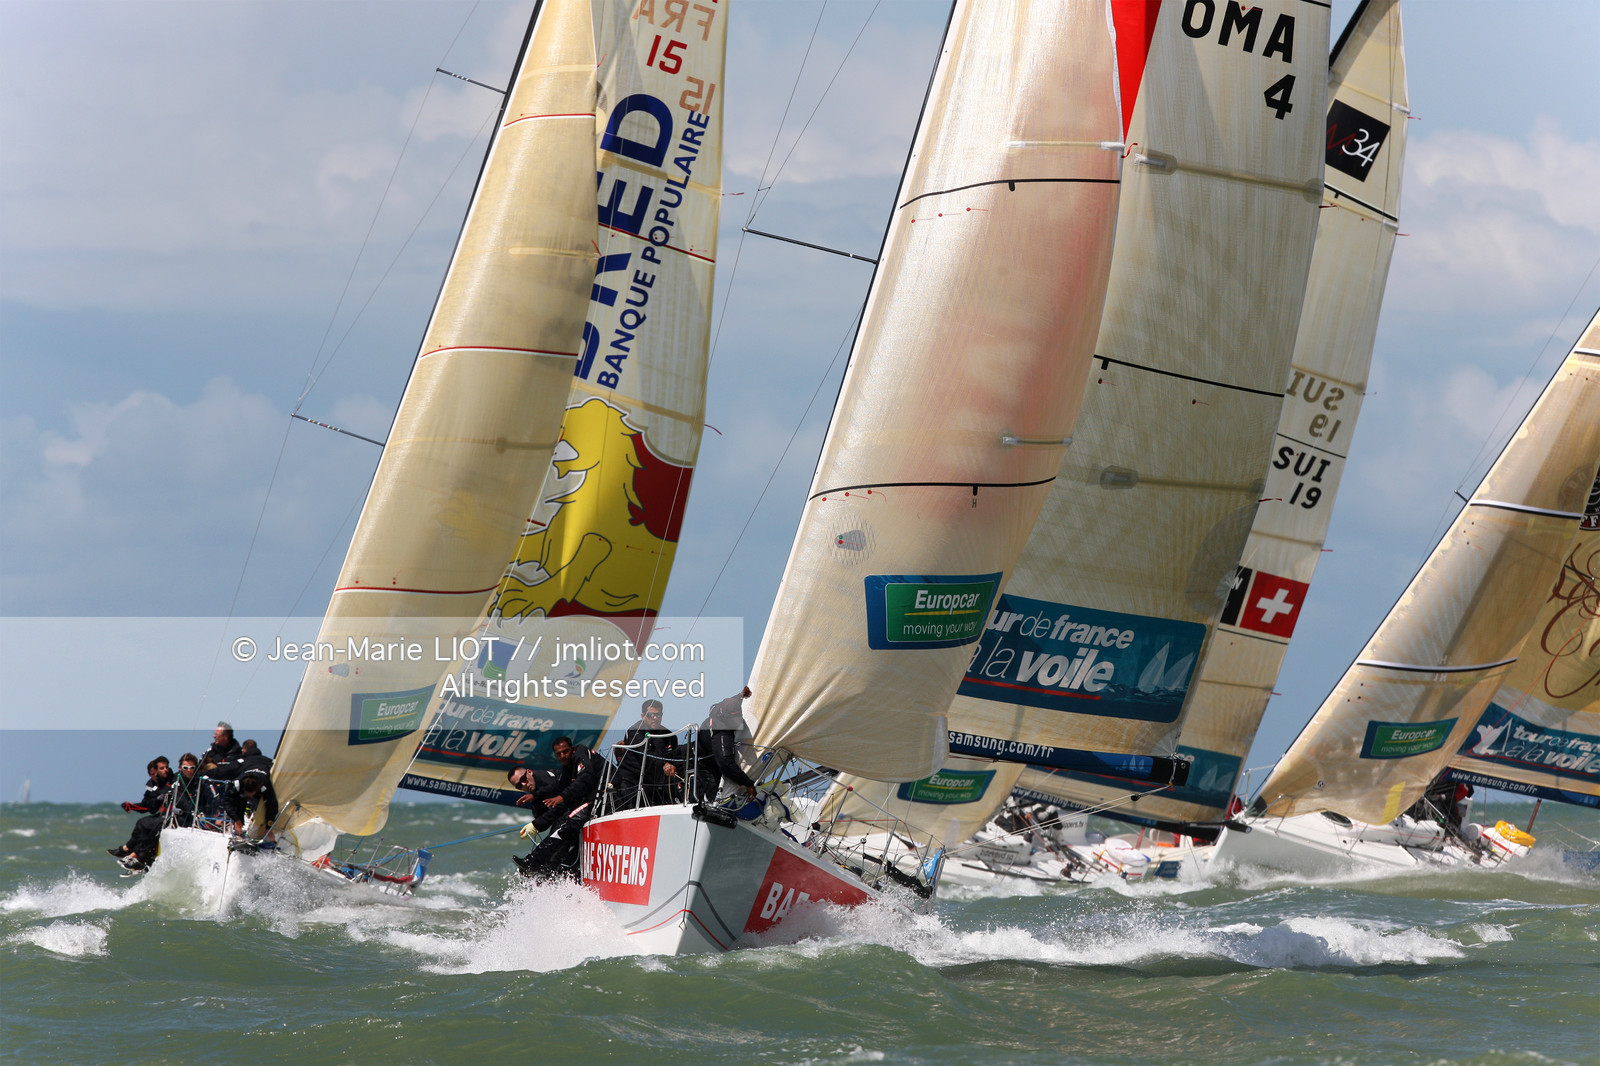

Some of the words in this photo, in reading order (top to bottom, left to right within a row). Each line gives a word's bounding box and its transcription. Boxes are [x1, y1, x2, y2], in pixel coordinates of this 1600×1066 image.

[1181, 0, 1296, 63] OMA
[646, 35, 688, 75] 15
[1263, 74, 1296, 120] 4
[597, 269, 656, 389] BANQUE
[640, 111, 710, 265] POPULAIRE
[1272, 446, 1331, 483] SUI
[1289, 482, 1322, 509] 19
[914, 589, 980, 615] Europcar
[903, 622, 943, 638] moving
[945, 621, 964, 636] your
[986, 609, 1024, 632] ur
[1019, 610, 1051, 638] de
[1049, 614, 1135, 649] france
[979, 636, 1015, 678] la
[1016, 648, 1115, 692] voile
[377, 701, 419, 718] Europcar
[436, 700, 474, 719] our
[471, 705, 495, 724] de
[492, 708, 554, 732] france
[441, 721, 467, 750] la
[465, 730, 537, 759] voile
[948, 730, 1054, 758] samsung.com/fr
[1391, 729, 1437, 743] Europcar
[1513, 725, 1552, 743] tour
[1566, 737, 1600, 753] fran
[1521, 744, 1544, 762] la
[1544, 751, 1600, 774] voile
[406, 775, 502, 799] www.samsung.com/fr
[929, 774, 975, 789] Europcar
[1451, 771, 1538, 794] www.samsung.com/fr
[596, 842, 649, 887] SYSTEMS
